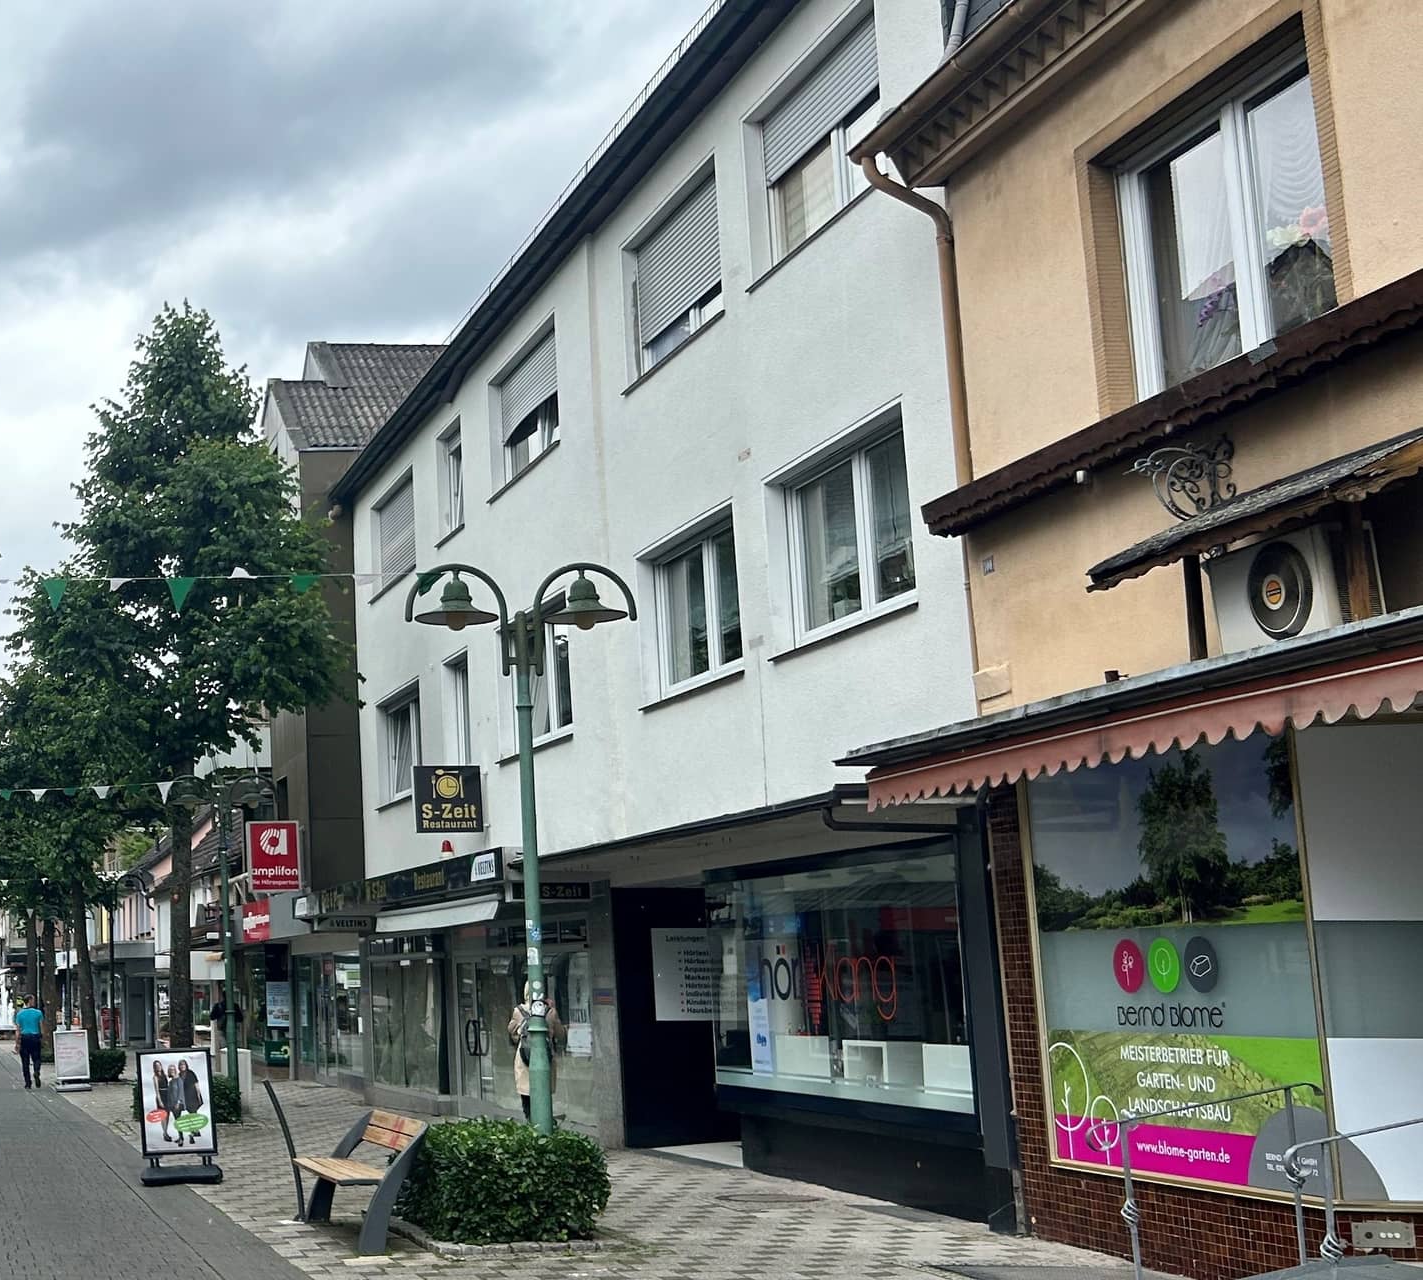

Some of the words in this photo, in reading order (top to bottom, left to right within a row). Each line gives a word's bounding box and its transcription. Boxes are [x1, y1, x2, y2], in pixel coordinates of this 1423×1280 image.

[421, 803, 477, 819] S-Zeit
[422, 819, 478, 829] Restaurant
[252, 866, 298, 878] amplifon
[542, 885, 582, 898] S-Zeit
[336, 917, 368, 929] VELTINS
[1117, 1002, 1166, 1026] Bernd
[1120, 1045, 1204, 1065] MEISTERBETRIEB
[1206, 1046, 1231, 1066] FÜR
[1136, 1071, 1185, 1090] GARTEN-
[1188, 1075, 1216, 1093] UND
[1128, 1096, 1231, 1122] LANDSCHAFTSBAU
[1136, 1139, 1231, 1163] www.blome-garten.de
